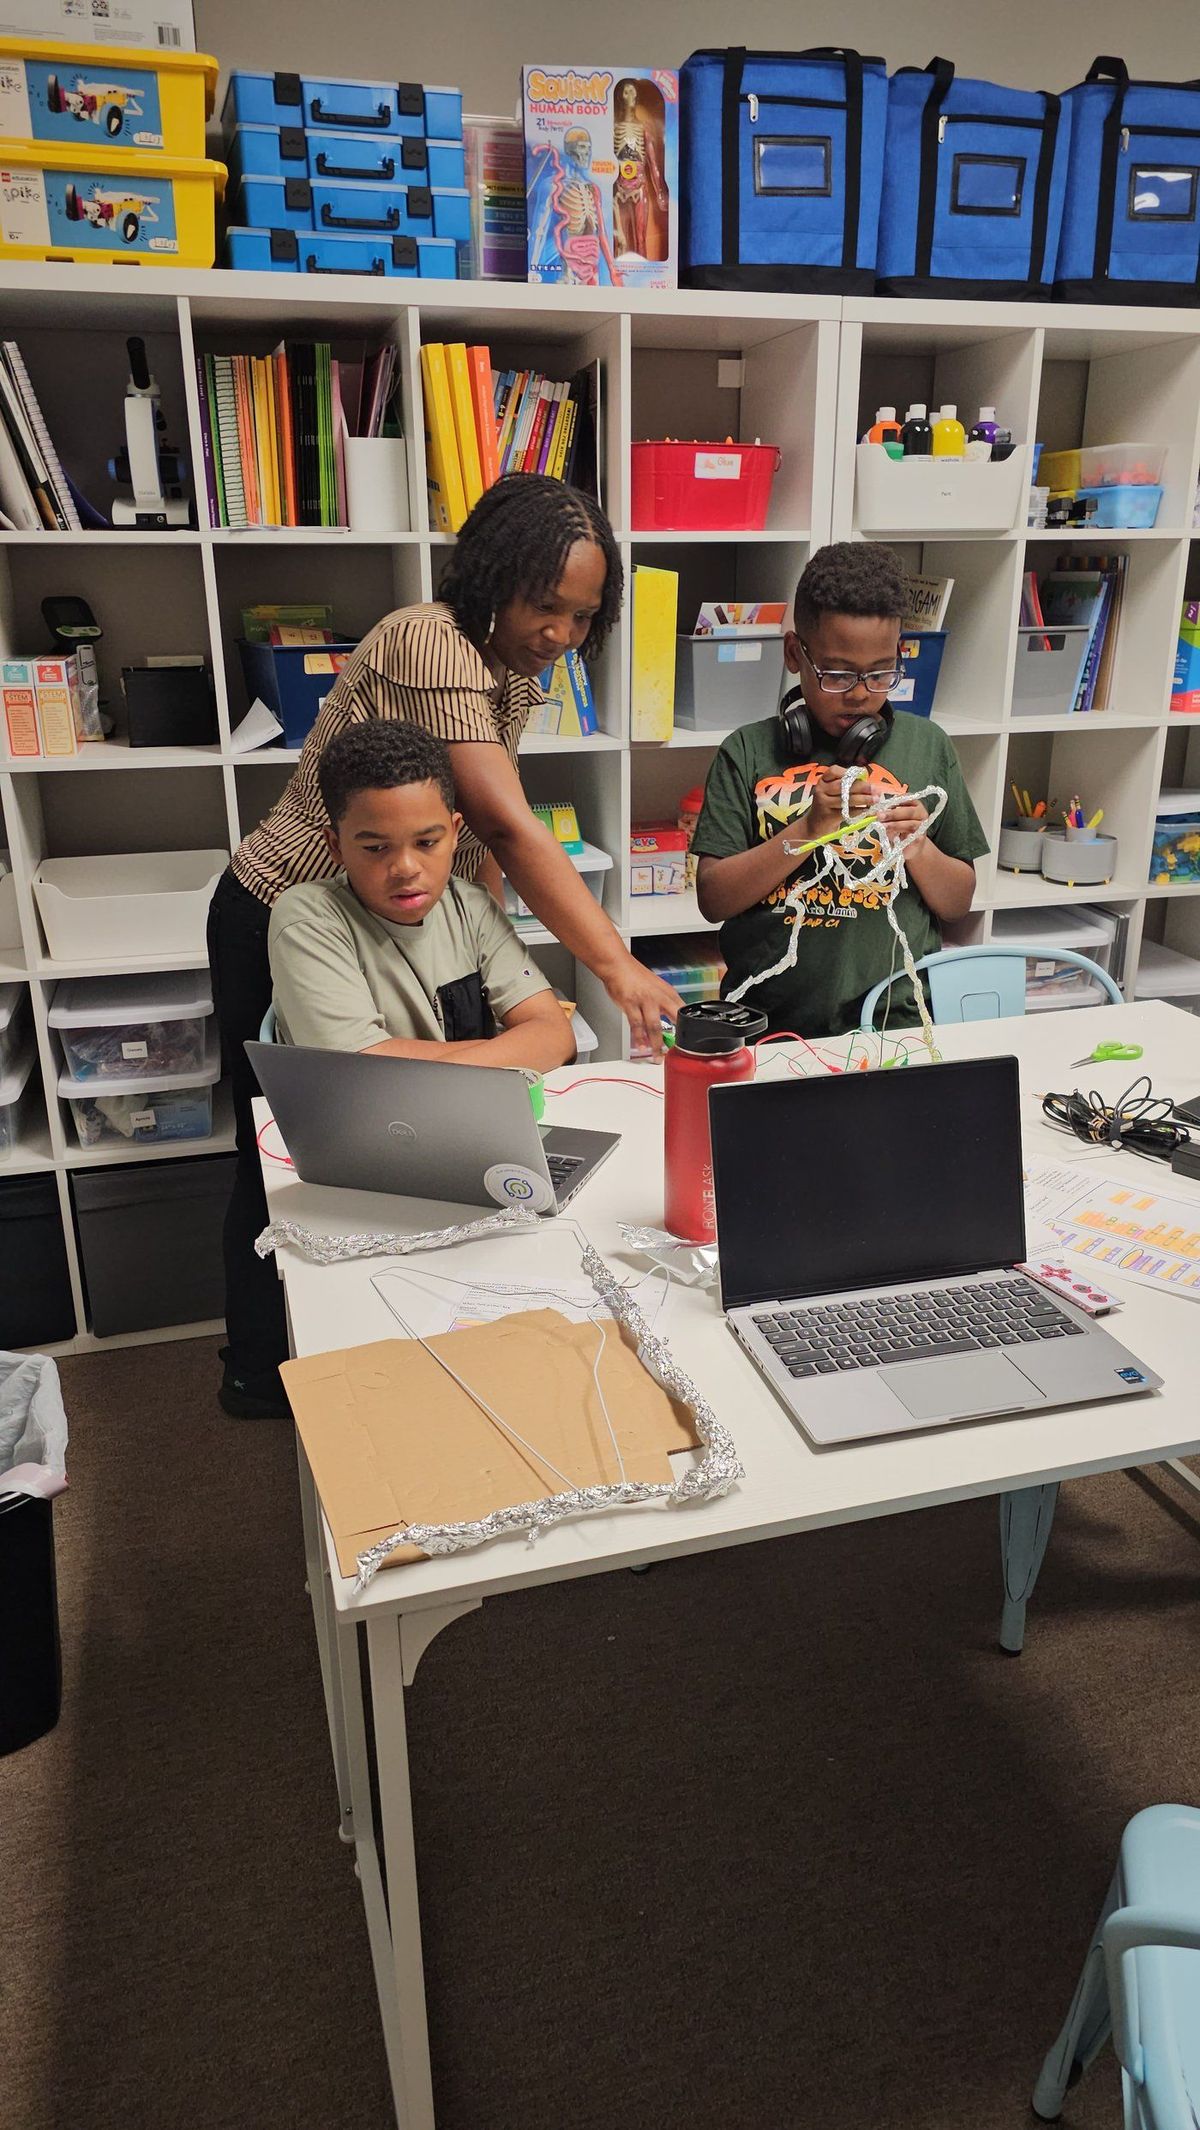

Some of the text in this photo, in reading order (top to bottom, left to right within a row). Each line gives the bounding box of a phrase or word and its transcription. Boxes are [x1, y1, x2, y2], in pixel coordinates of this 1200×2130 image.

[530, 105, 609, 115] HUMAN BODY
[536, 118, 546, 127] 21
[909, 590, 942, 616] IGAMI
